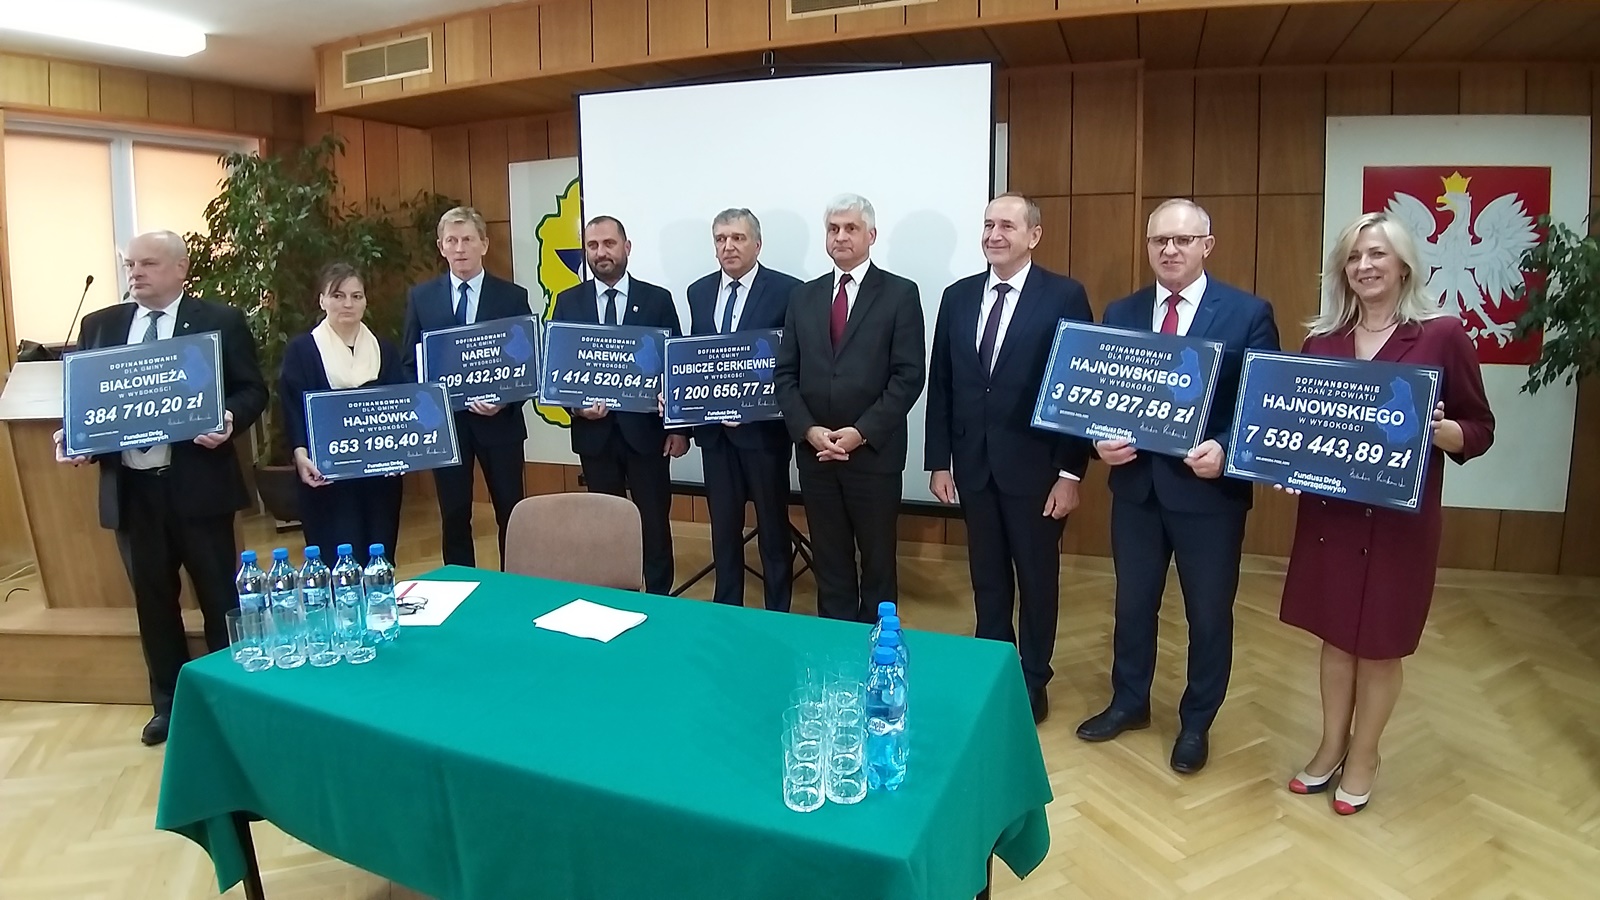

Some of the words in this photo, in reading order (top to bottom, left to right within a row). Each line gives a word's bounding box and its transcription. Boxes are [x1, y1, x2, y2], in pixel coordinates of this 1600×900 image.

[455, 332, 507, 344] DOFINANSOWANIE
[581, 336, 636, 345] DOFINANSOWANIE
[462, 347, 501, 361] NAREW
[577, 350, 636, 362] NAREWKA
[698, 346, 750, 354] DOFINANSOWANIE
[1100, 343, 1173, 361] DOFINANSOWANIE
[110, 355, 178, 370] DOFINANSOWANIE
[672, 362, 714, 375] DUBICZE
[716, 358, 776, 372] CERKIEWNE
[1107, 353, 1122, 361] DLA
[1125, 354, 1161, 366] POWIATU
[141, 364, 164, 372] GMINY
[466, 367, 510, 384] 432,30
[513, 364, 526, 378] zł
[1070, 356, 1192, 388] HAJNOWSKIEGO
[100, 369, 187, 393] BIAŁOWIEŻA
[551, 370, 559, 382] 1
[563, 370, 590, 384] 414
[593, 373, 641, 388] 520,64
[644, 376, 658, 388] zł
[1295, 376, 1381, 393] DOFINANSOWANIE
[128, 386, 172, 397] WYSOKOŚCI
[672, 387, 680, 400] 1
[685, 385, 709, 399] 200
[713, 382, 759, 399] 656,77
[763, 382, 775, 395] zł
[1296, 386, 1325, 396] ZADAŃ
[1335, 390, 1377, 402] POWIATU
[84, 406, 117, 425] 384
[123, 396, 182, 420] 710,20
[187, 392, 203, 409] zł
[349, 398, 411, 408] DOFINANSOWANIE
[1052, 383, 1065, 400] 3
[1067, 386, 1103, 407] 575
[1105, 392, 1172, 420] 927,58
[1173, 406, 1196, 424] zł
[1263, 393, 1405, 426] HAJNOWSKIEGO
[343, 411, 419, 427] HAJNÓWKA
[1310, 417, 1364, 433] WYSOKOŚCI
[124, 431, 148, 441] Fundusz
[149, 429, 163, 437] Dróg
[1092, 422, 1117, 434] Fundusz
[1117, 425, 1133, 438] Dróg
[119, 434, 169, 446] Samorządowych
[329, 439, 359, 454] 653
[364, 434, 419, 450] 196,40
[423, 430, 438, 444] zł
[1245, 424, 1260, 444] 7
[1263, 429, 1304, 451] 538
[1307, 435, 1384, 465] 443,89
[1388, 449, 1413, 469] zł
[364, 464, 409, 473] Samorządowych
[367, 461, 389, 469] Fundusz
[1288, 477, 1347, 494] Samorządowych
[1294, 471, 1322, 483] Fundusz
[1323, 475, 1342, 487] Dróg
